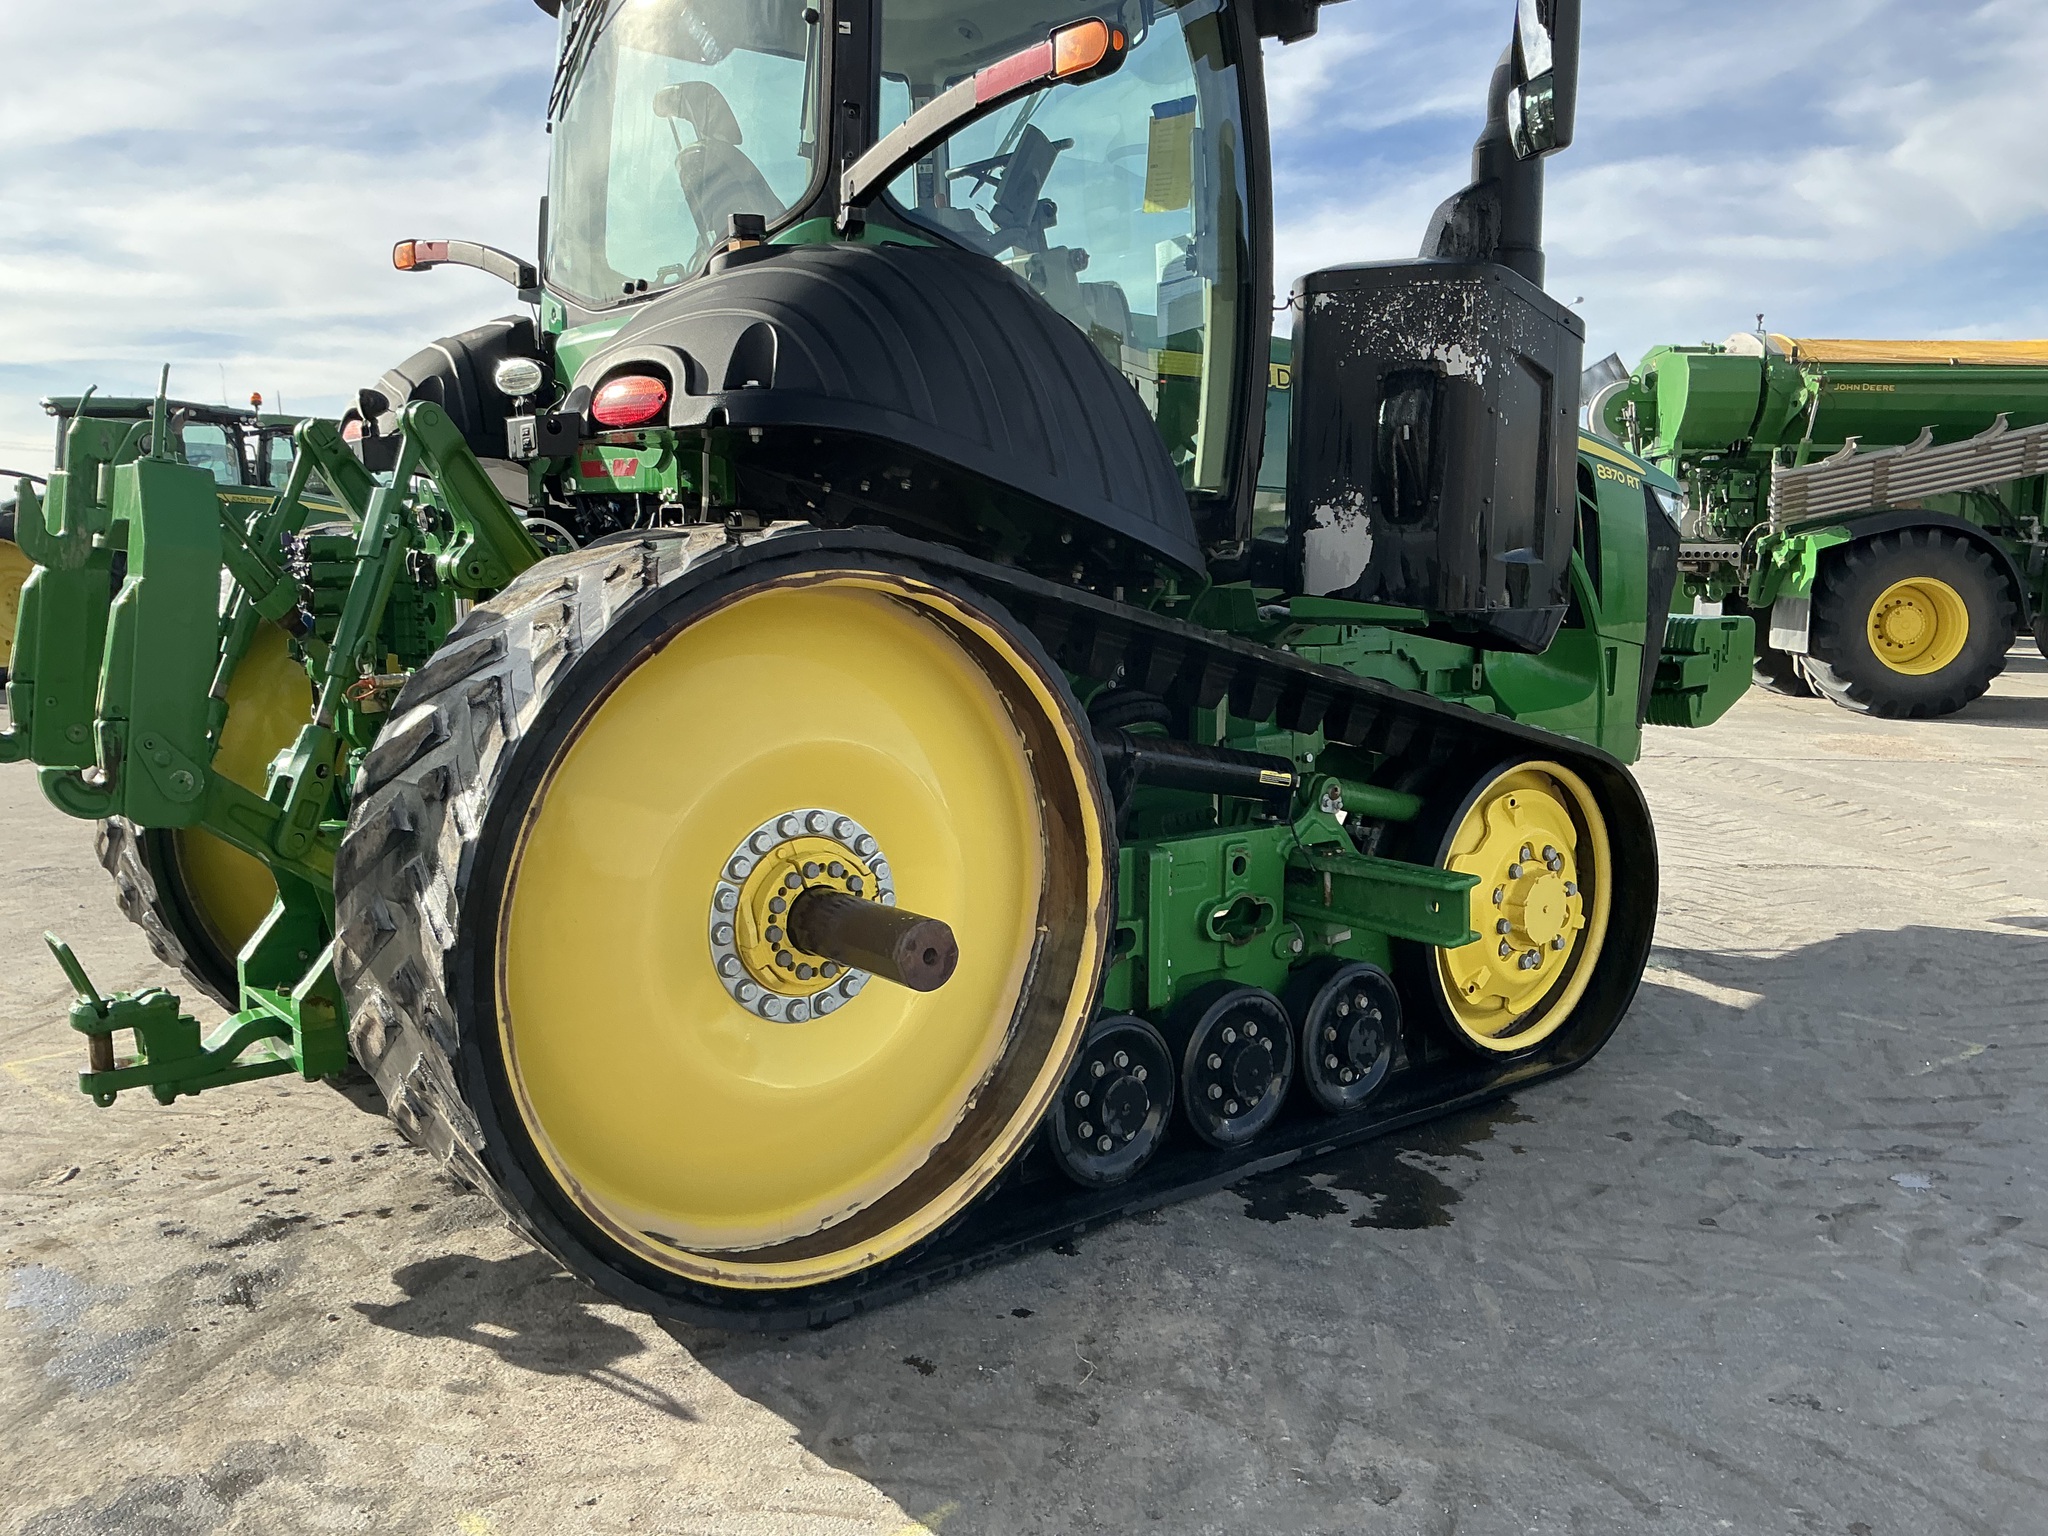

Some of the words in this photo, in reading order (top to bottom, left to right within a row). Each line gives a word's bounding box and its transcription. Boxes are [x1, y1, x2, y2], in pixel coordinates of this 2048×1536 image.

[1833, 383, 1860, 391] JOHN
[1862, 383, 1895, 391] DEERE
[1596, 463, 1625, 484] 8370
[1626, 474, 1640, 490] RT
